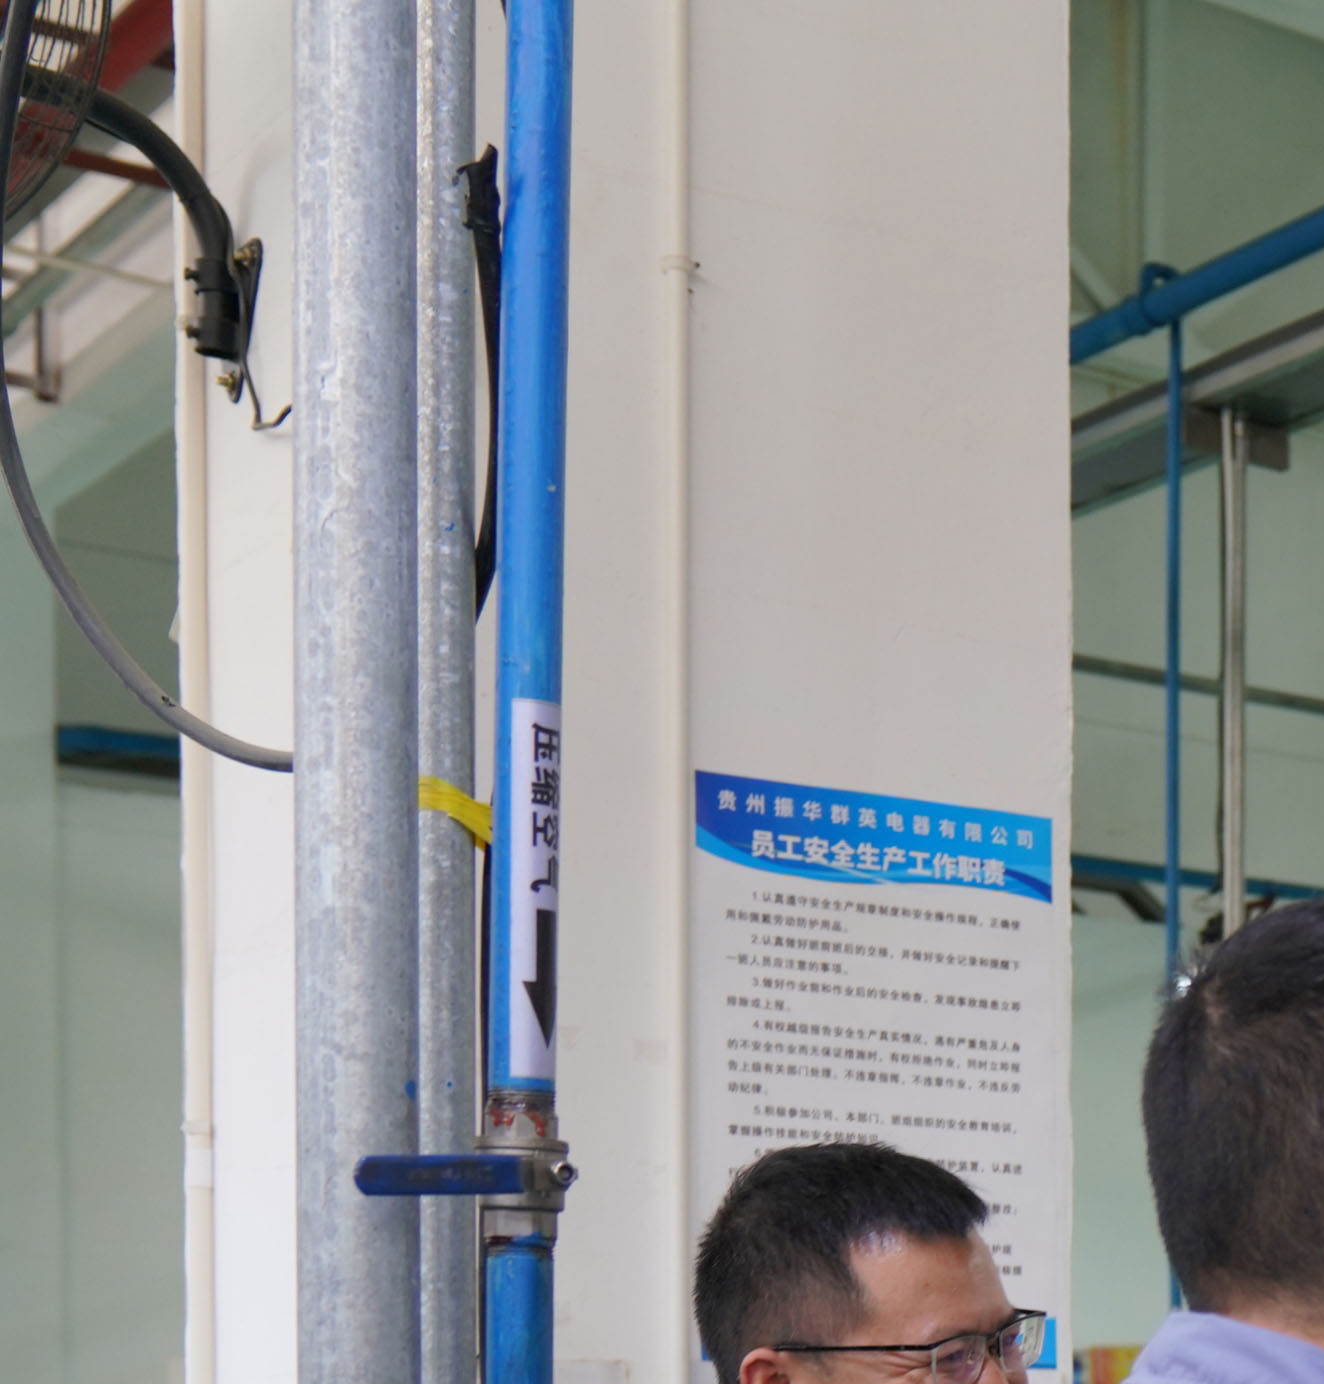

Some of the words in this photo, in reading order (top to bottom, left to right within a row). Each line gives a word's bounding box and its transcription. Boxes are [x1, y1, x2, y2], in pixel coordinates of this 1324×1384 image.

[530, 723, 560, 893] 压缩空气
[717, 790, 1035, 850] 贵州振华群英电器有限公司
[750, 829, 1006, 887] 员工安全生产工作职责
